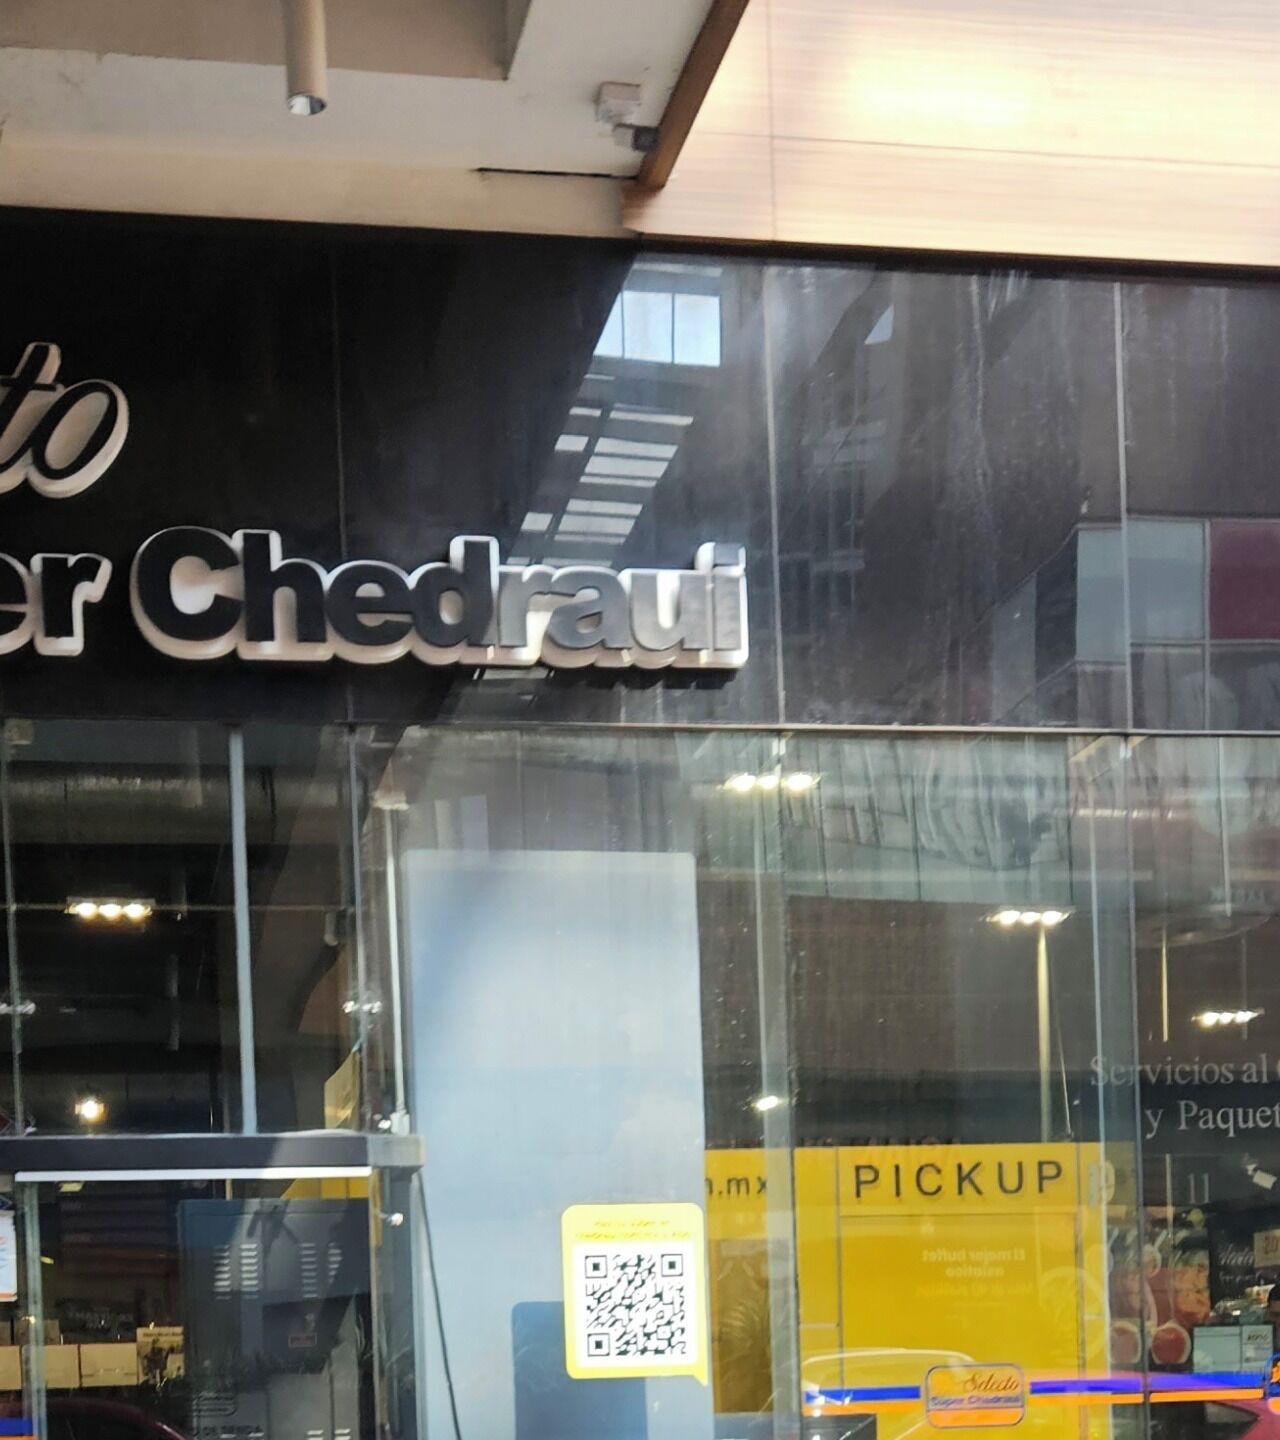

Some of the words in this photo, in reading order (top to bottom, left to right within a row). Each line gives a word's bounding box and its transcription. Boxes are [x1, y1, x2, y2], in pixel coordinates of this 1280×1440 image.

[131, 525, 749, 672] Chedraui
[1090, 1054, 1235, 1087] Servicios
[1242, 1053, 1268, 1083] al
[1145, 1107, 1164, 1140] y
[855, 1159, 1063, 1199] PICKUP
